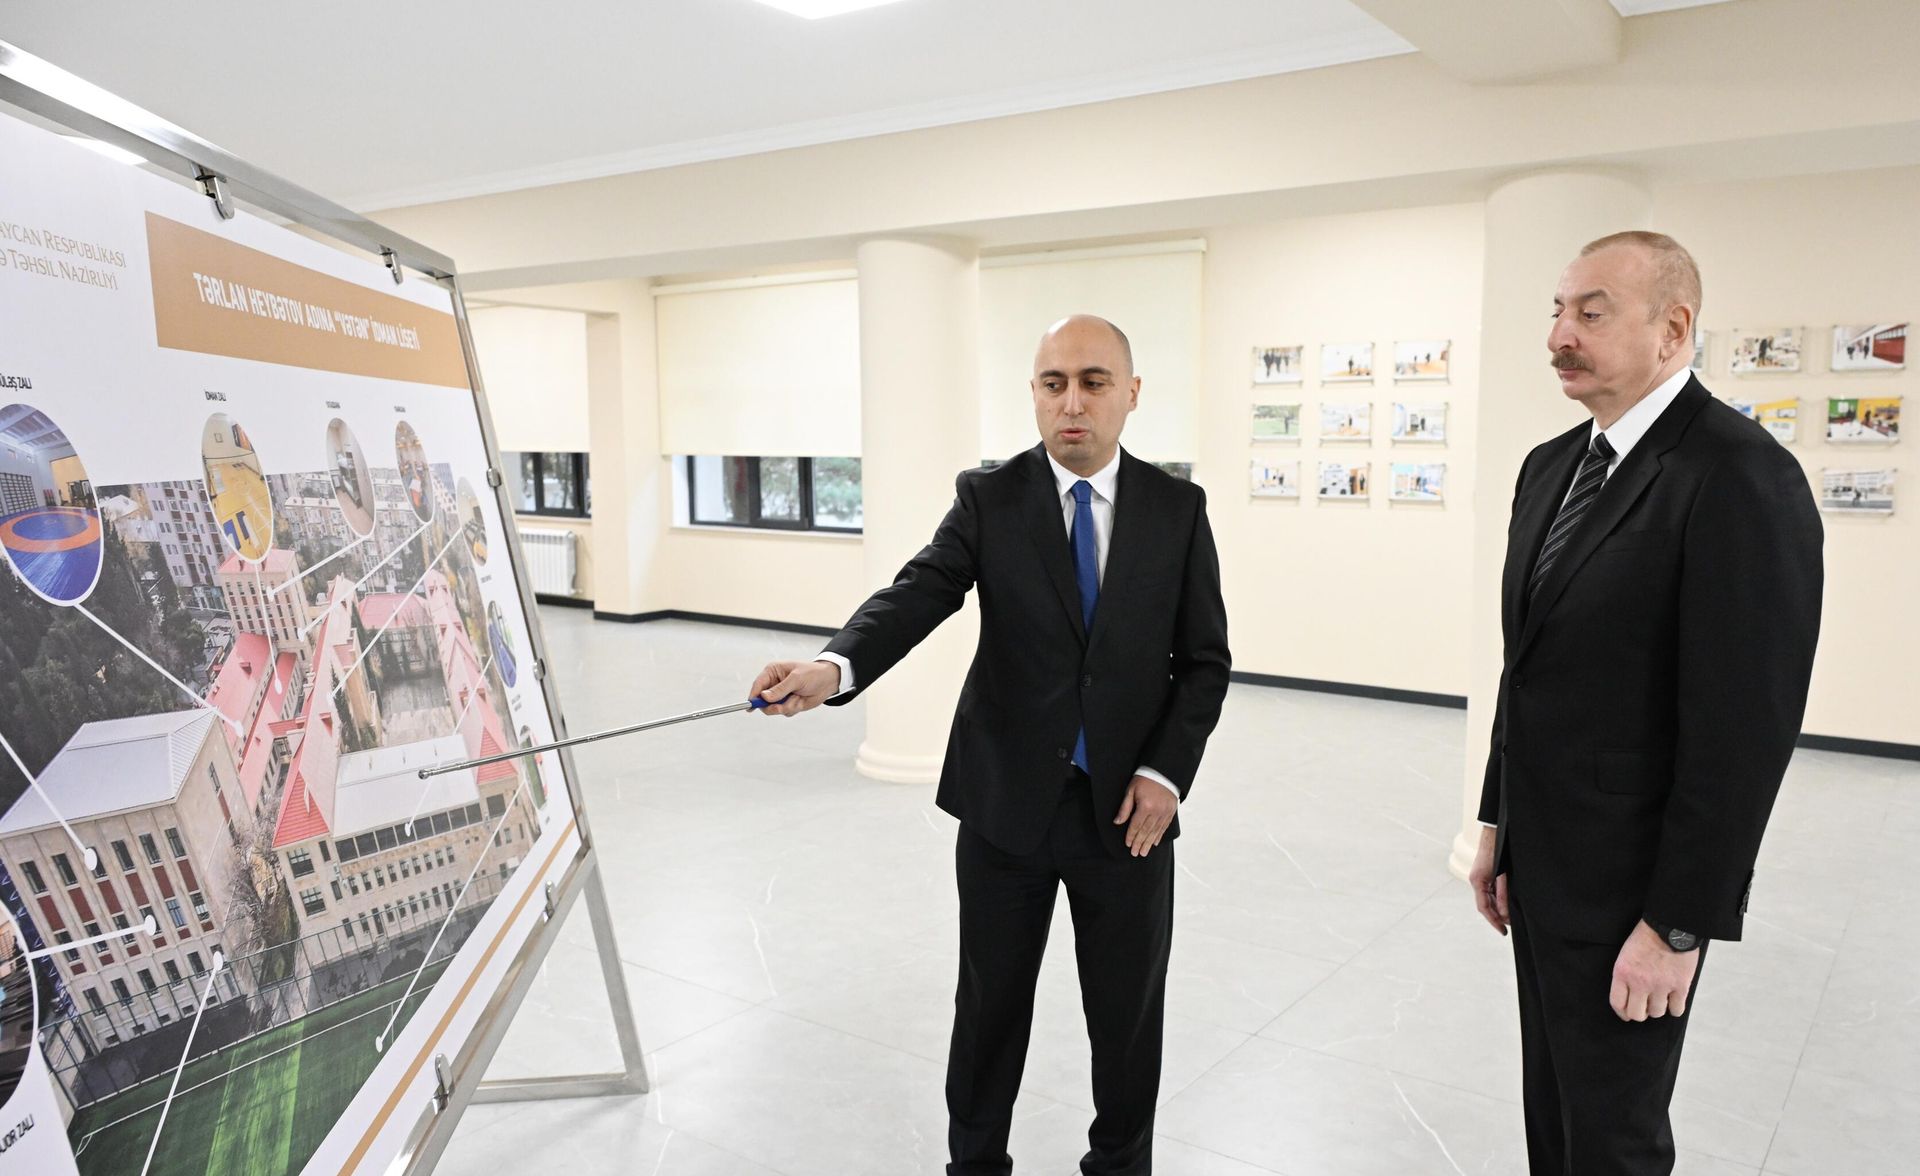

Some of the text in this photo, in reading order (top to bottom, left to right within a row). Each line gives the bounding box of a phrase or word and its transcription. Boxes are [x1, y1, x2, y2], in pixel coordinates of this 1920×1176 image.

[7, 248, 59, 278] TƏHSİL
[43, 229, 127, 268] RESPUBLİKASI
[193, 272, 249, 313] TƏRLAN
[247, 287, 304, 326] HEYBƏTOV
[304, 303, 337, 333] ADINA
[17, 376, 33, 389] ZALI
